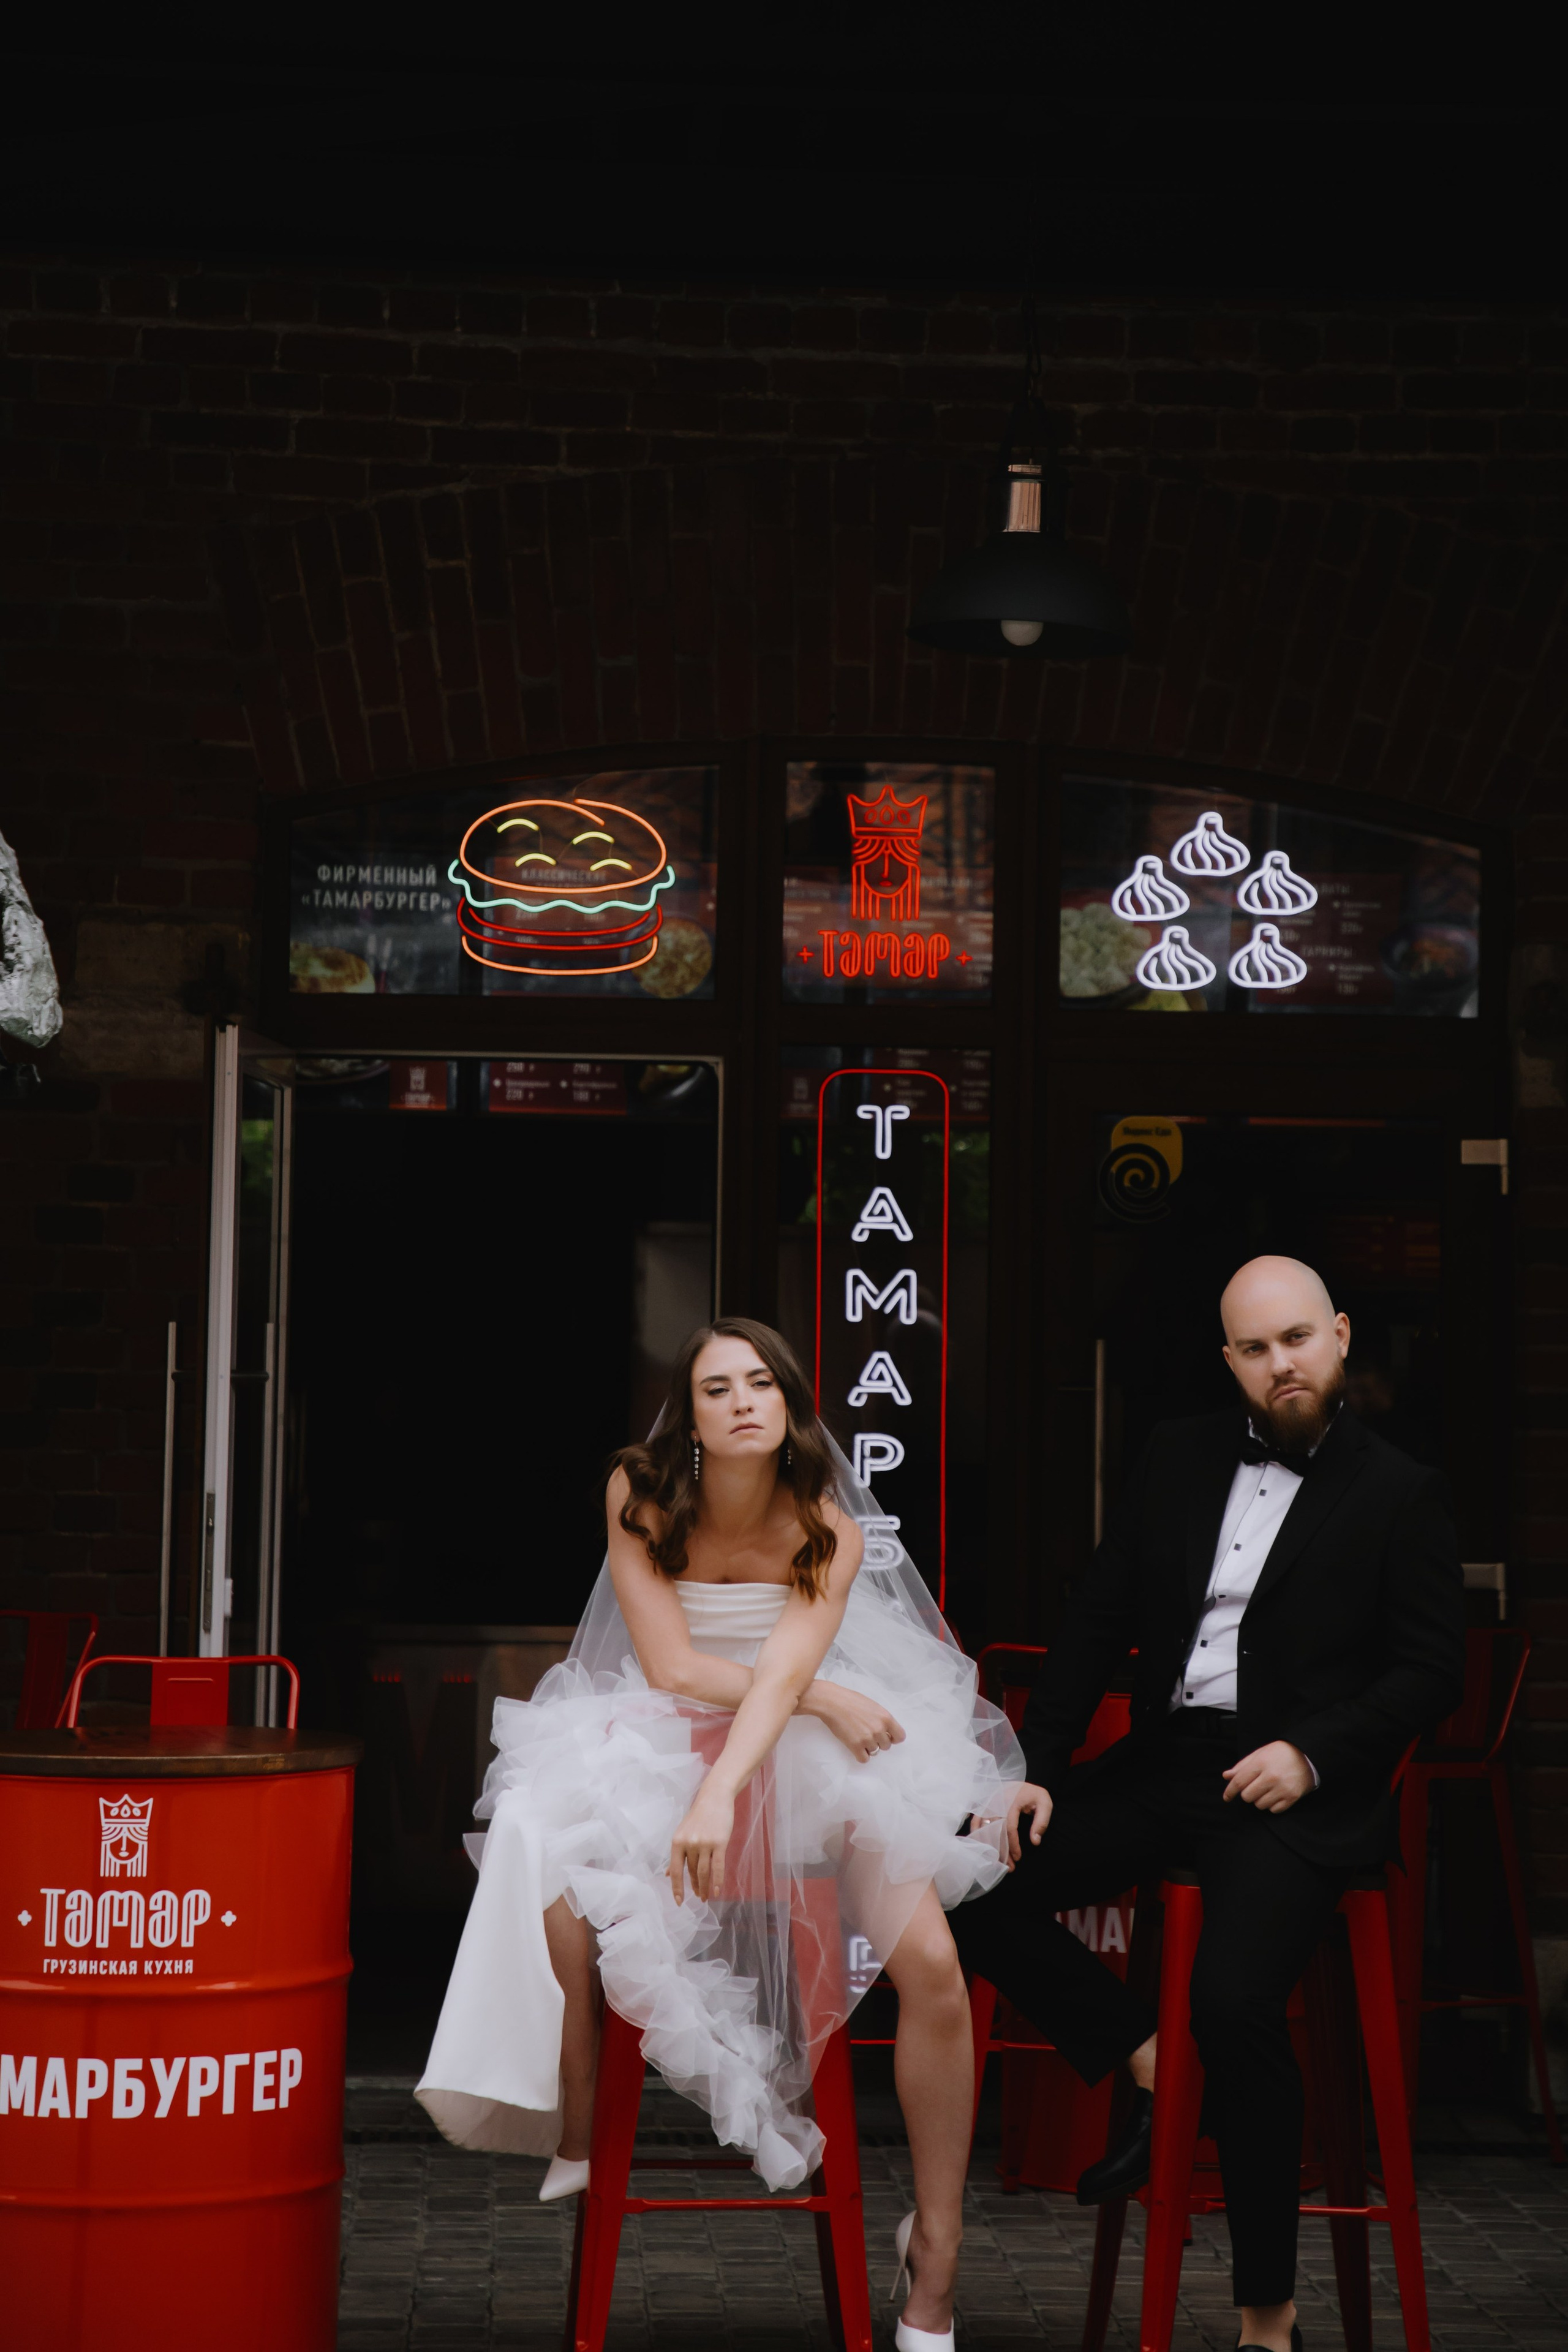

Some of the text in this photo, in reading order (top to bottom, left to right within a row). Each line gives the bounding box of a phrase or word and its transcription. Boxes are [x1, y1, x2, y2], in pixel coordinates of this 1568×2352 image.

[317, 864, 437, 886] ФИРМЕННЫЙ
[301, 889, 452, 911] «ТАМАРБУРГЕР»
[43, 1958, 194, 1975] ГРУЗИНСКАЯ КУХНЯ
[0, 2048, 303, 2119] МАРБУРГЕР
